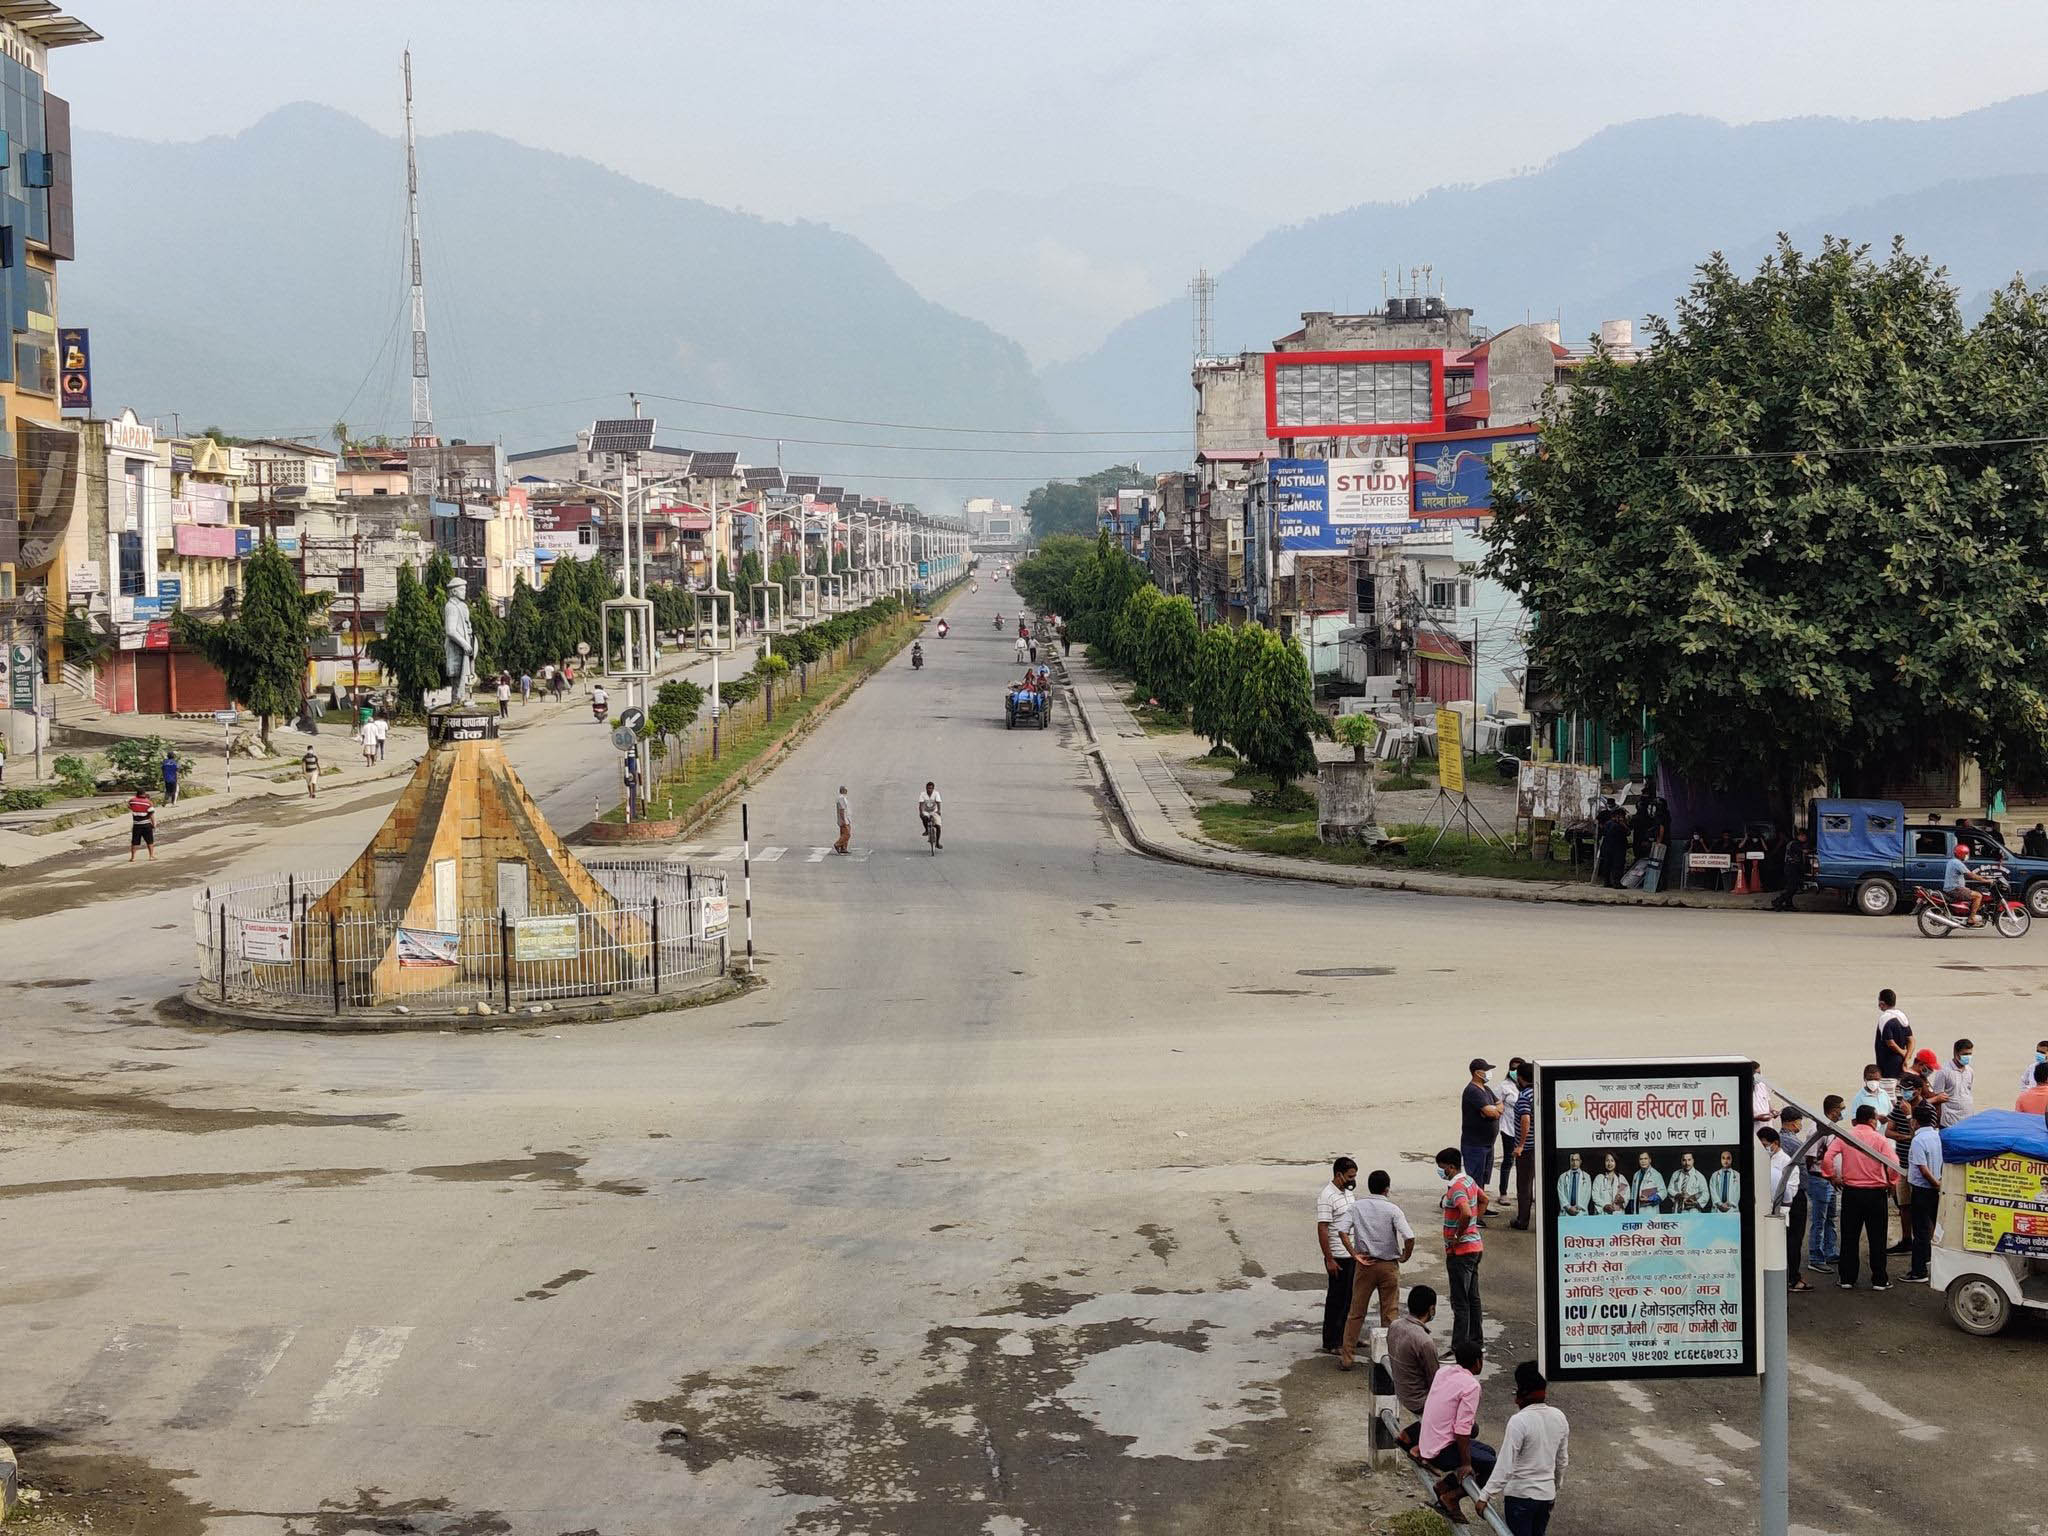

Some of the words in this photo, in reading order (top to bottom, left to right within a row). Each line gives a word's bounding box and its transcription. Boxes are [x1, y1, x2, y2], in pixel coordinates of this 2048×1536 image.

[118, 426, 149, 449] JAPAN
[1337, 474, 1409, 491] STUDY
[1279, 525, 1320, 537] JAPAN
[1637, 1093, 1688, 1120] हस्पिटल
[1692, 1099, 1707, 1120] प्रा.
[1711, 1092, 1730, 1118] लि.
[1644, 1130, 1662, 1143] ५००
[1667, 1126, 1690, 1141] मिटर
[2018, 1202, 2037, 1211] Skill
[1973, 1208, 1997, 1221] Free
[1564, 1234, 1605, 1249] विशेषज्ञ
[1564, 1259, 1597, 1274] सर्जरी
[1565, 1285, 1604, 1299] ओपिडि
[1609, 1285, 1638, 1300] शुल्क
[1696, 1284, 1721, 1296] मात्र
[1565, 1305, 1588, 1320] ICU
[1600, 1303, 1628, 1319] CCU
[1640, 1300, 1716, 1318] हेमोडाइलाइसिस
[1720, 1299, 1738, 1316] सेवा
[1587, 1324, 1608, 1336] घण्टा
[1721, 1320, 1738, 1335] सेवा
[1628, 1338, 1658, 1348] सम्पर्क
[1674, 1348, 1739, 1362] ९८६९६७२८३३
